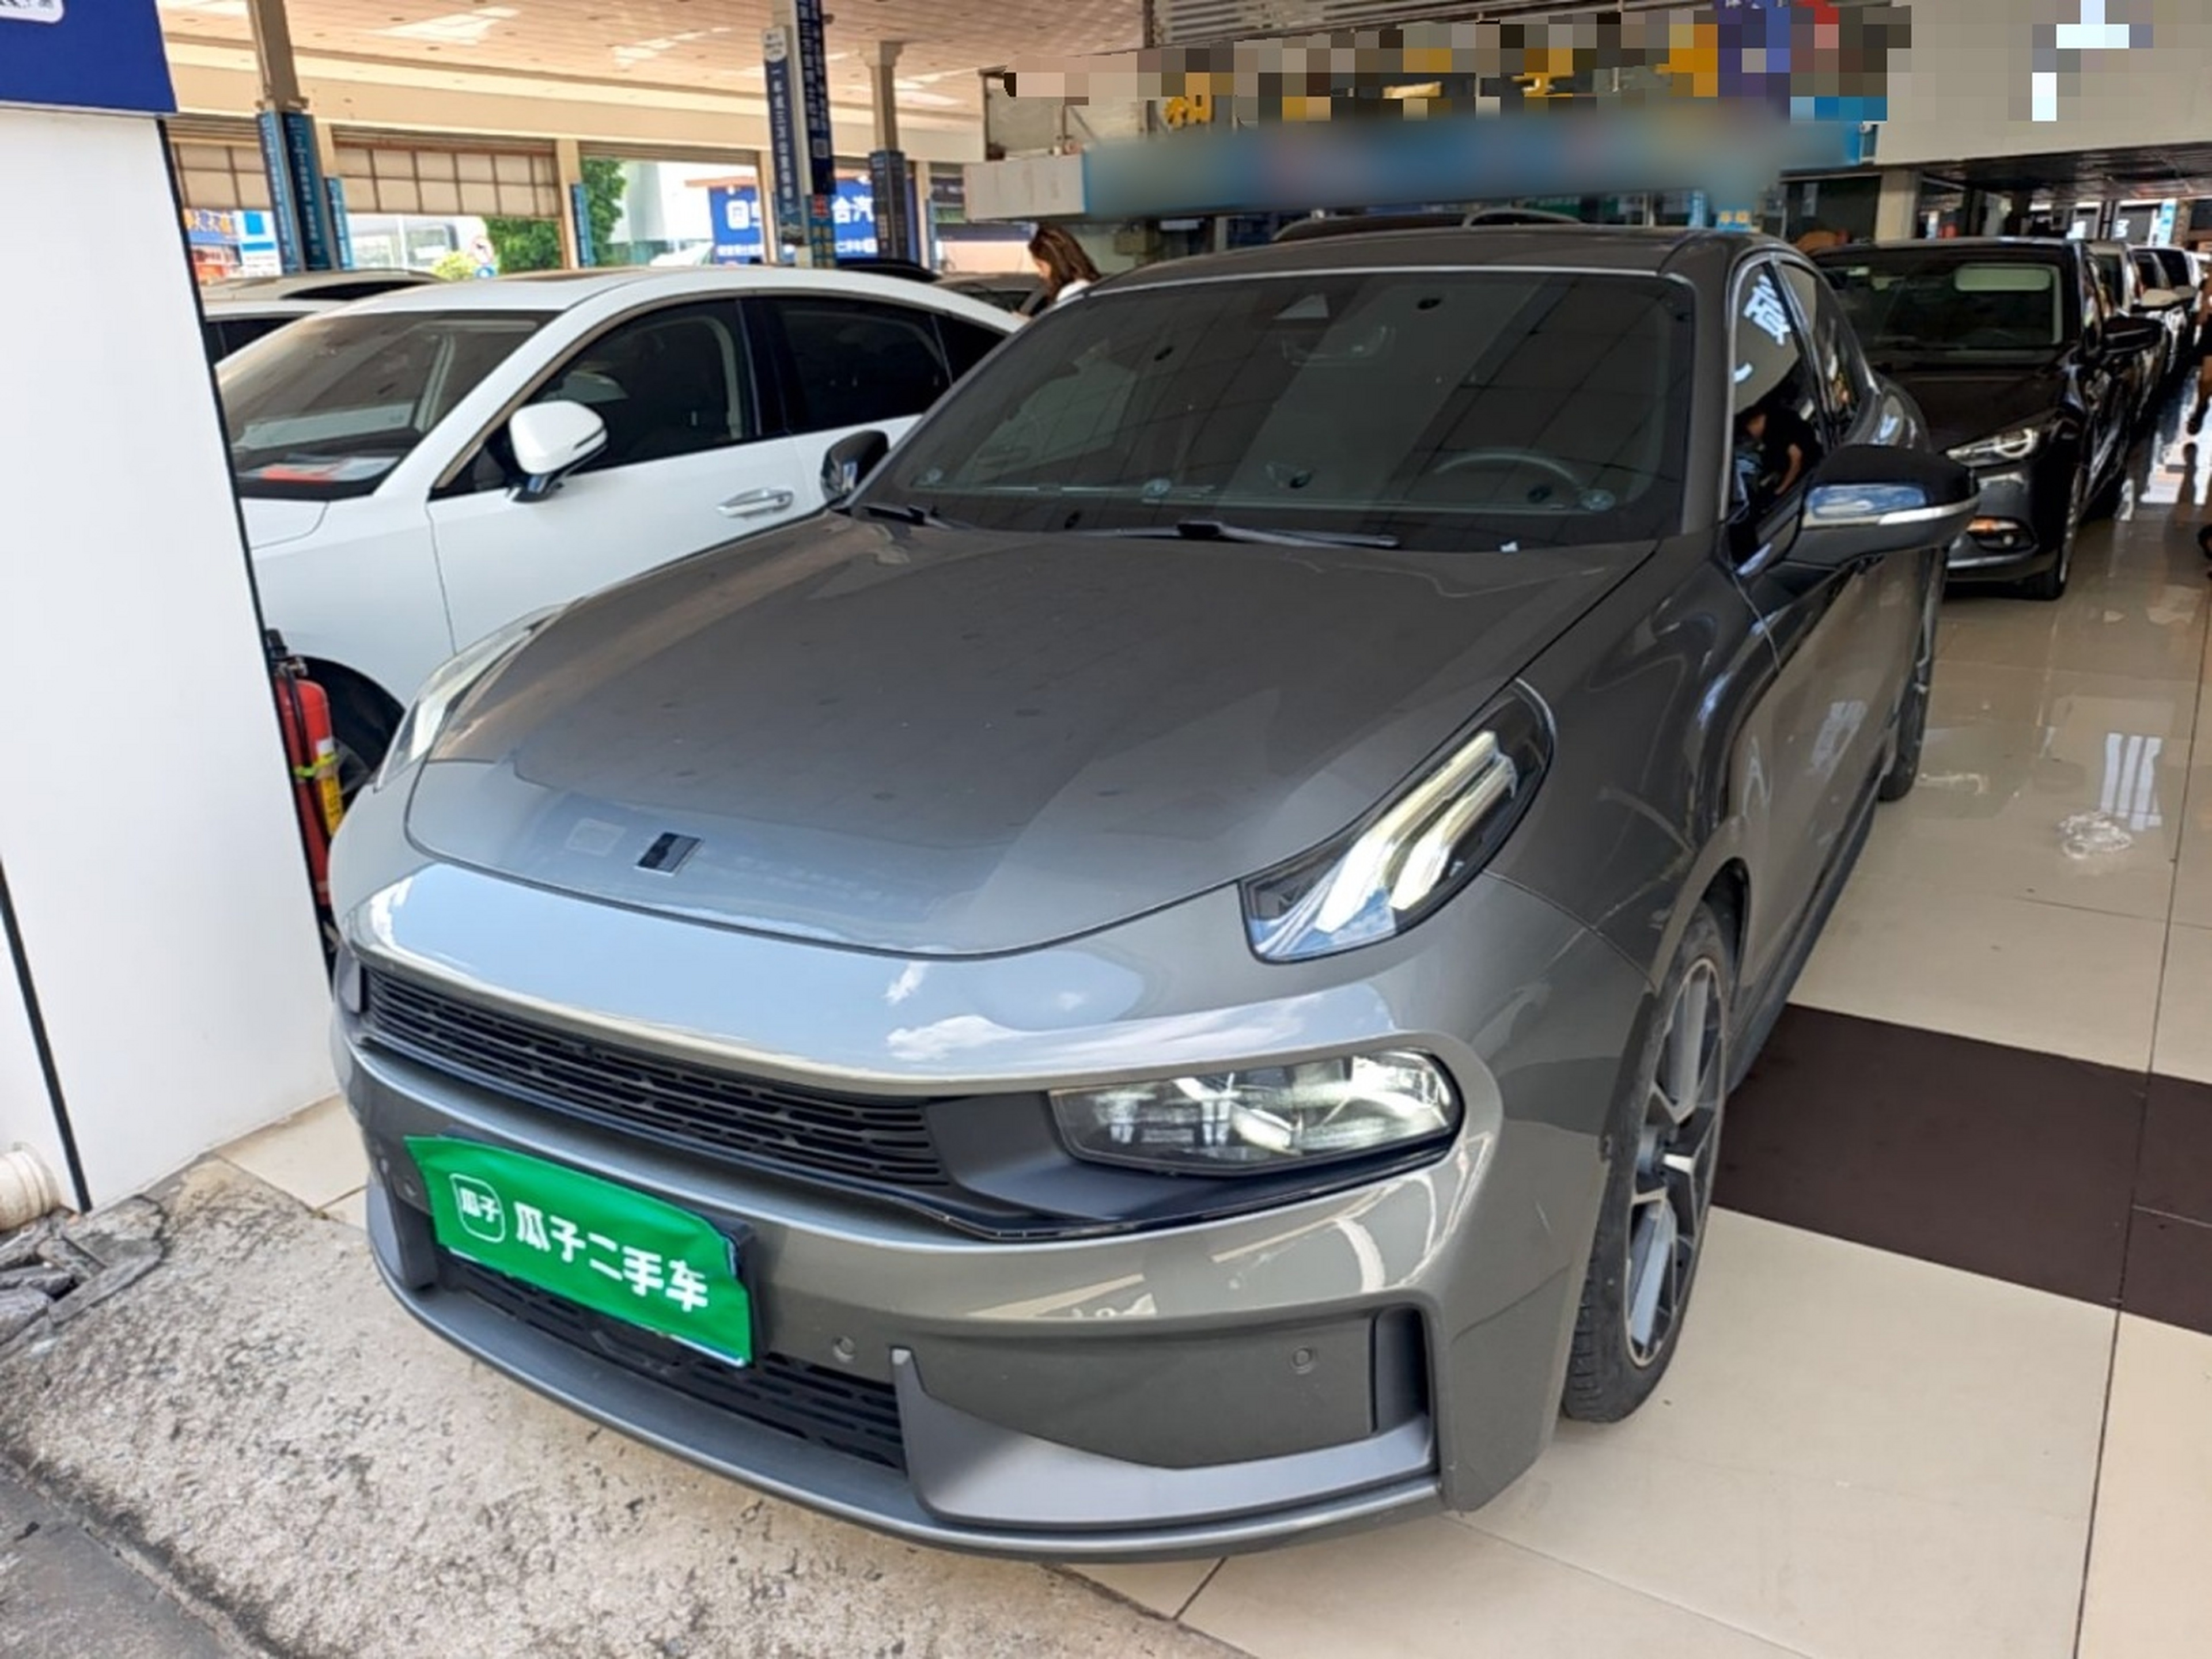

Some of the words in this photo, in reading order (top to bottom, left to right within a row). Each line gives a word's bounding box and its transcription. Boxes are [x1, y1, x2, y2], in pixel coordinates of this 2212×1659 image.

[459, 1187, 502, 1222] 瓜子
[514, 1201, 709, 1312] 瓜子二手车
